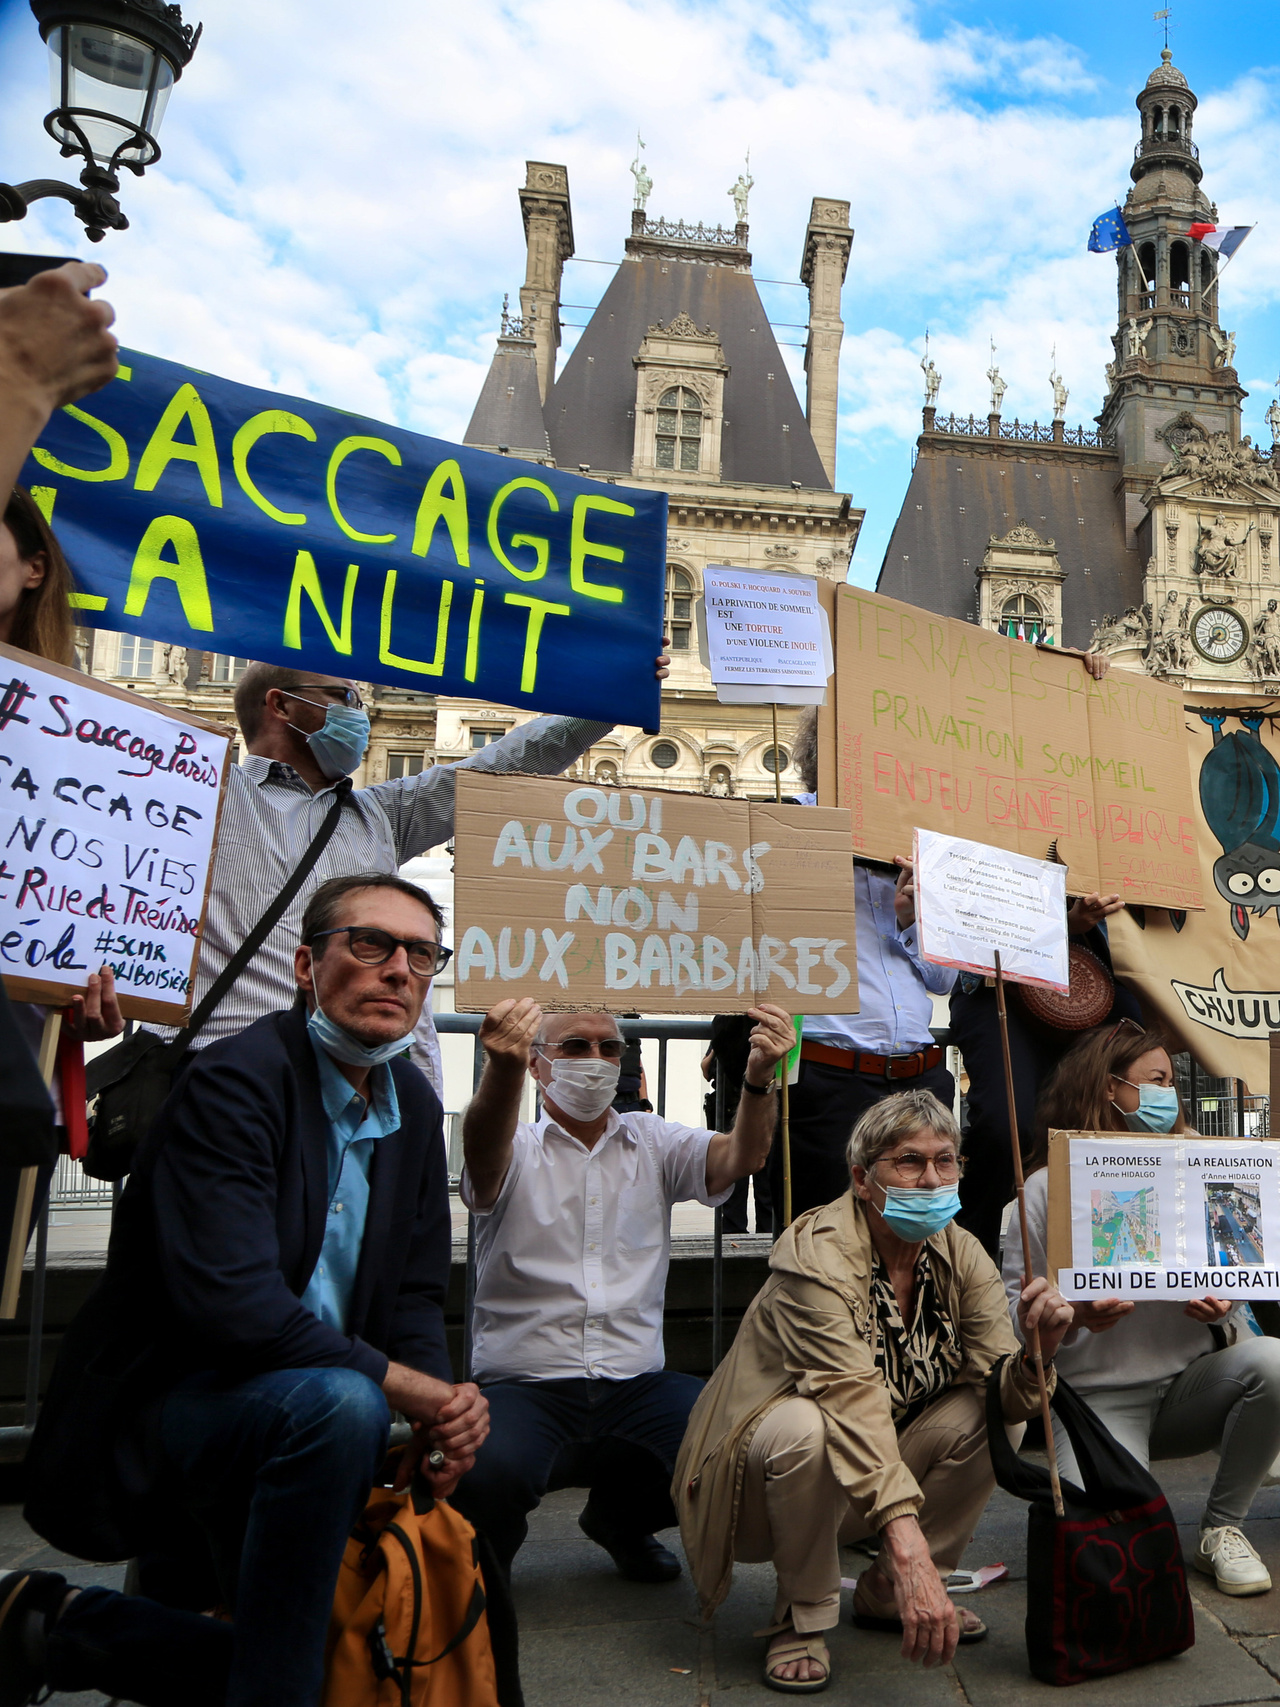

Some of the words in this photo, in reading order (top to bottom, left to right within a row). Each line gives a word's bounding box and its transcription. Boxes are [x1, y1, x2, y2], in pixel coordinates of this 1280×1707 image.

[719, 581, 741, 589] POLSKI
[711, 597, 724, 606] LA
[725, 598, 767, 610] PRIVATION
[769, 602, 779, 611] DE
[780, 603, 814, 615] SOMMEIL
[718, 610, 734, 619] EST
[724, 622, 744, 632] UNE
[745, 623, 783, 634] TORTURE
[726, 638, 748, 646] D'UNE
[748, 638, 789, 649] VIOLENCE
[843, 593, 1047, 701] TERRASSES
[1066, 669, 1181, 738] PARTOUT
[874, 751, 973, 813] ENJEU
[0, 755, 203, 838] ACCAGE
[563, 787, 662, 834] OUI
[5, 815, 103, 868] NOS
[492, 820, 614, 874] AUX
[631, 832, 772, 894] BARS
[969, 868, 998, 880] Terrasses
[1004, 877, 1022, 887] alcool
[1012, 869, 1038, 881] terrasses
[1011, 889, 1042, 903] hurlements
[564, 882, 699, 932] NON
[955, 908, 978, 918] Rendez
[1016, 901, 1025, 909] les
[962, 921, 975, 929] Non
[985, 926, 1001, 936] lobby
[94, 929, 167, 963] #SCMR
[937, 926, 955, 936] Place
[969, 934, 989, 943] sports
[1009, 944, 1033, 954] espaces
[1041, 951, 1054, 960] jeux
[458, 926, 576, 989] AUX
[604, 932, 852, 998] BARBARES
[1085, 1156, 1100, 1167] LA
[1102, 1156, 1162, 1167] PROMESSE
[1188, 1157, 1202, 1167] LA
[1204, 1157, 1273, 1168] REALISATION
[1121, 1171, 1155, 1179] HIDALGO
[1228, 1173, 1261, 1181] HIDALGO
[1074, 1273, 1122, 1290] DENI
[1130, 1272, 1157, 1289] DE
